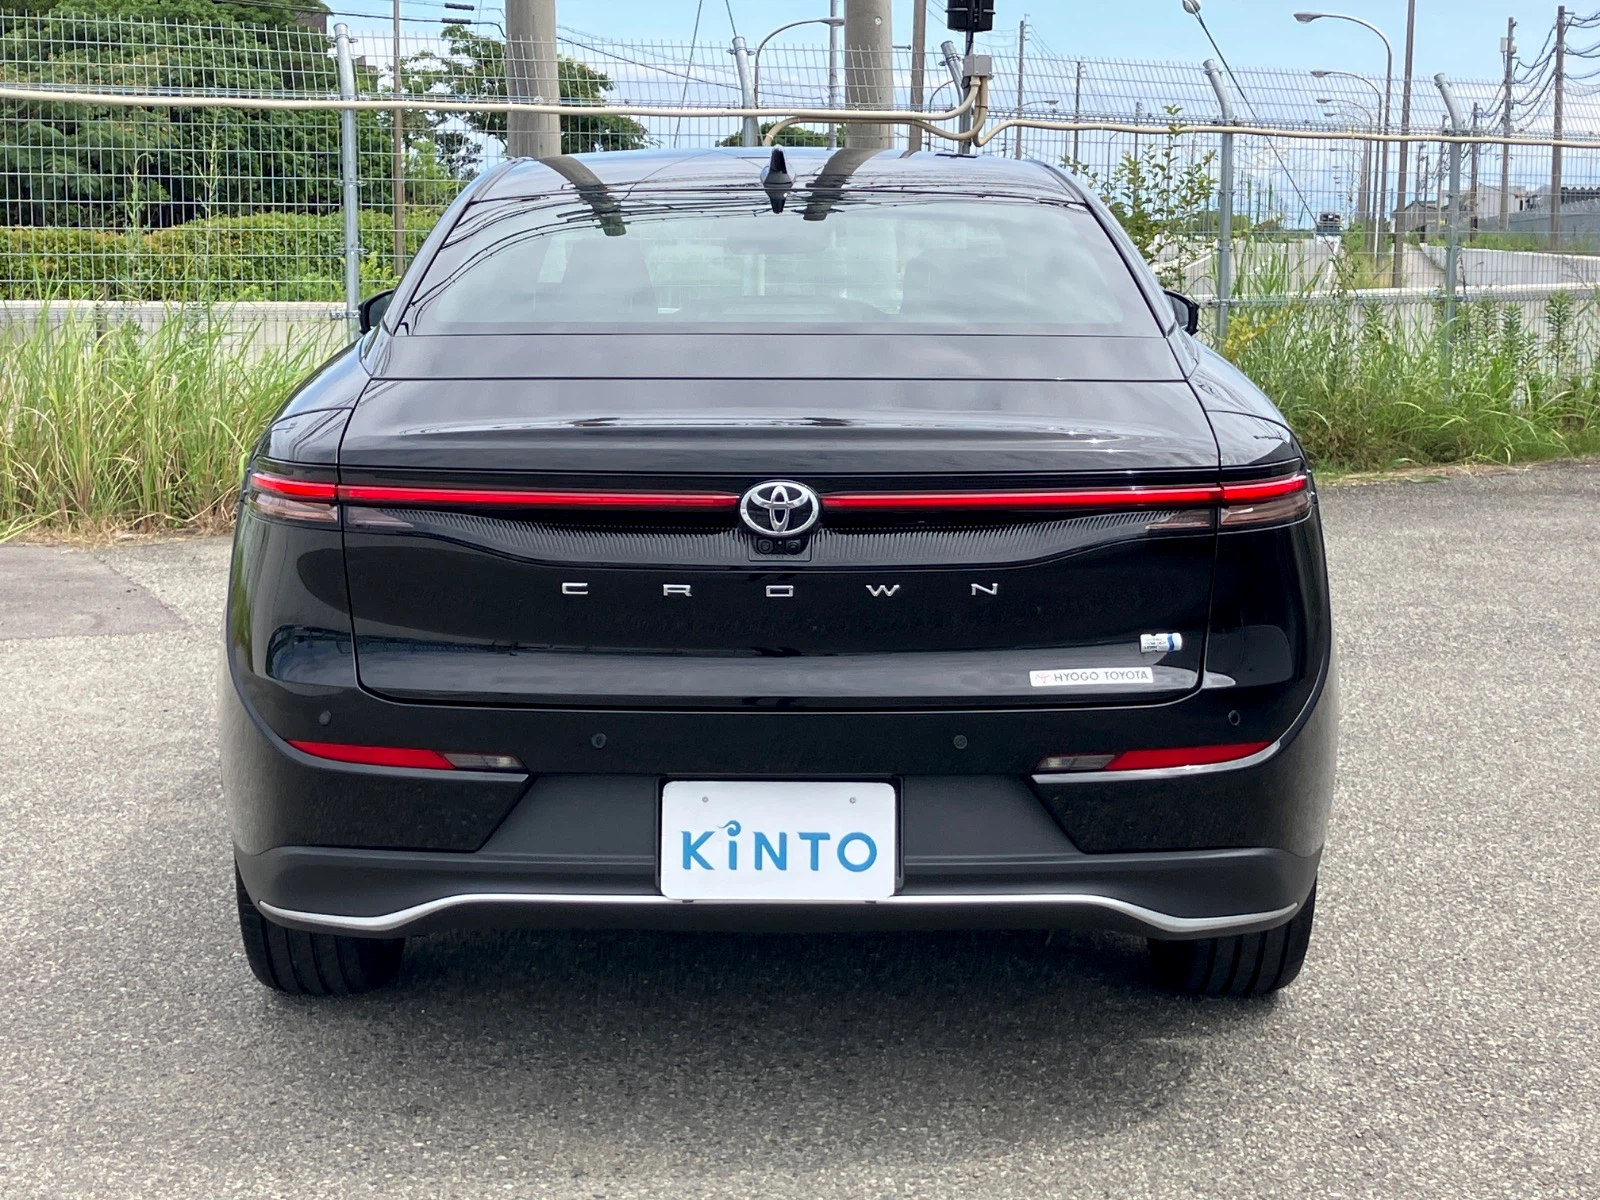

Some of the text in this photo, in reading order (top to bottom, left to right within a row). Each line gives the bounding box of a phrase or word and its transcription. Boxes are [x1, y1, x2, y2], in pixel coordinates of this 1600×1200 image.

[561, 582, 998, 598] CROWN
[1053, 669, 1149, 682] HYOGO TOYOTA
